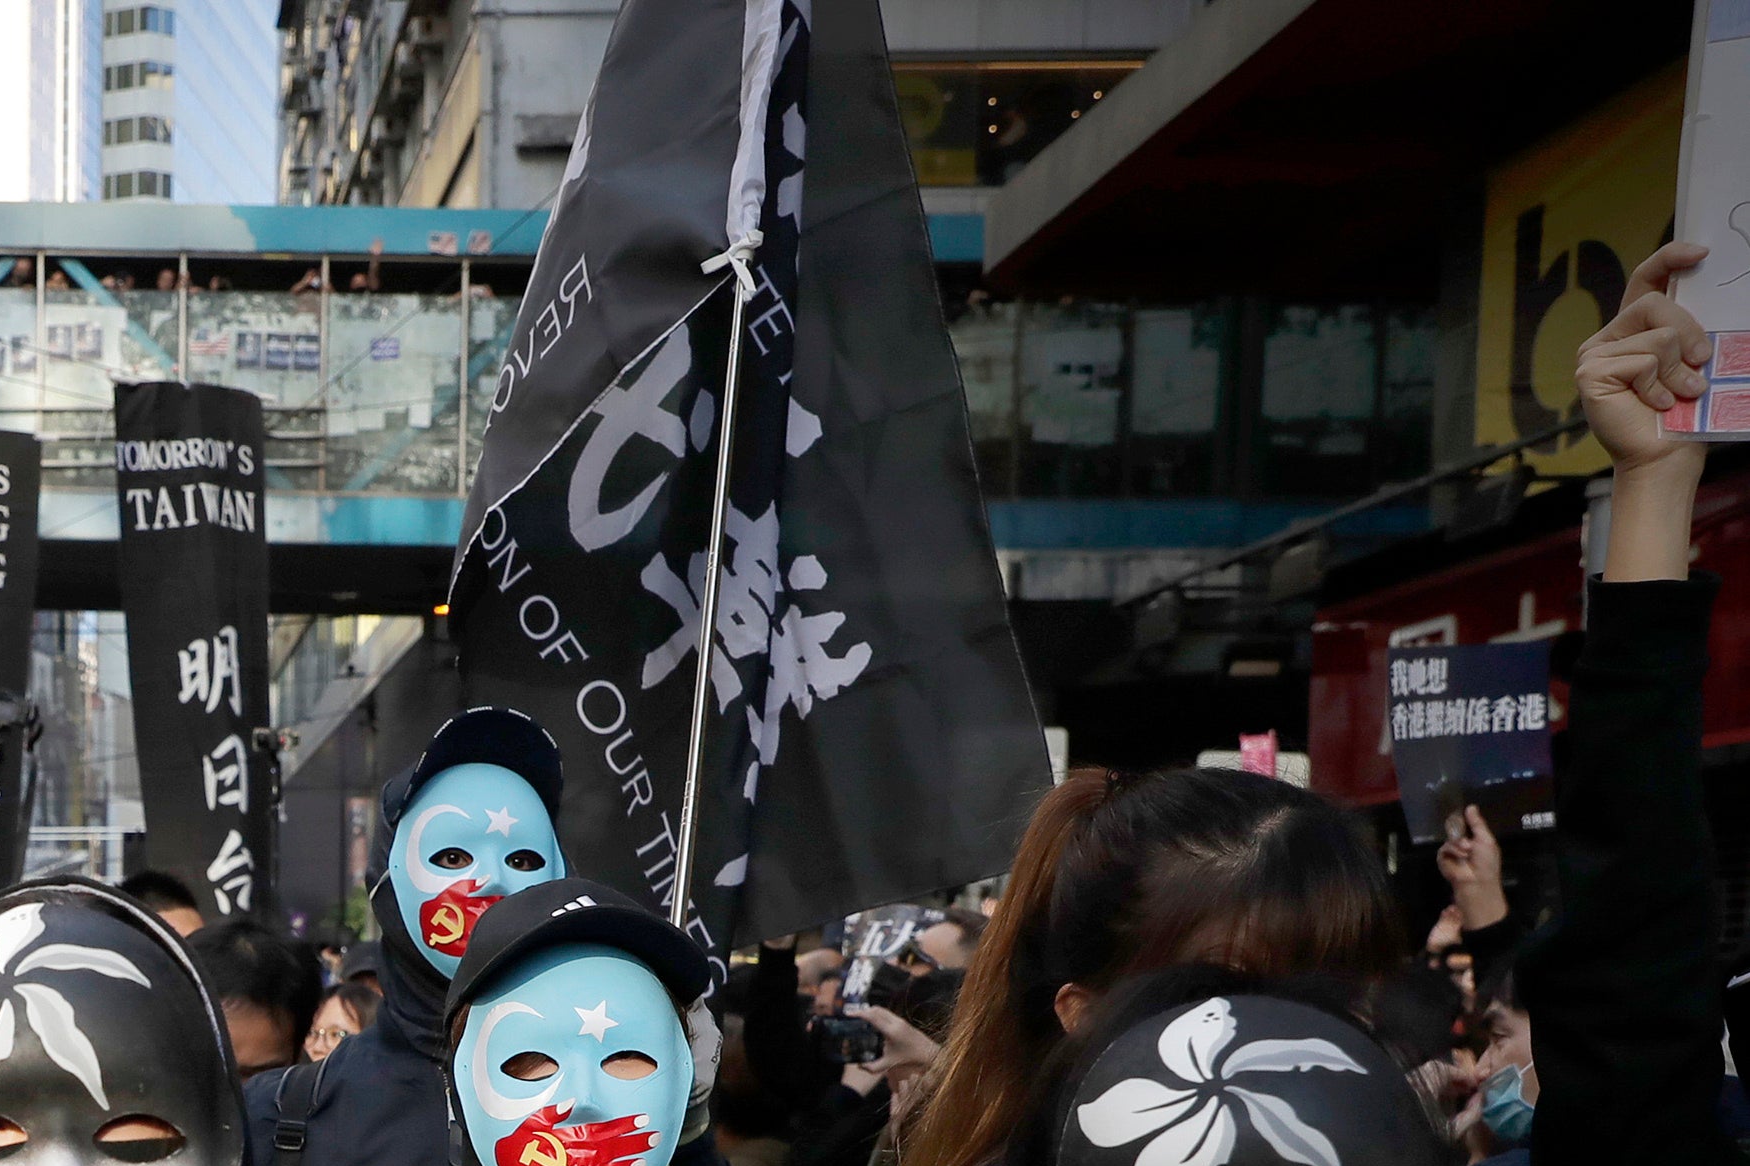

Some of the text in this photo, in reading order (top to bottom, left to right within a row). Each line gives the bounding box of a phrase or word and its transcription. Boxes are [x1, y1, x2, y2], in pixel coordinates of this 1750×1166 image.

[125, 481, 257, 534] TAIWAN
[177, 624, 254, 917] 明日台
[518, 594, 590, 664] OF
[575, 679, 657, 817] OUR
